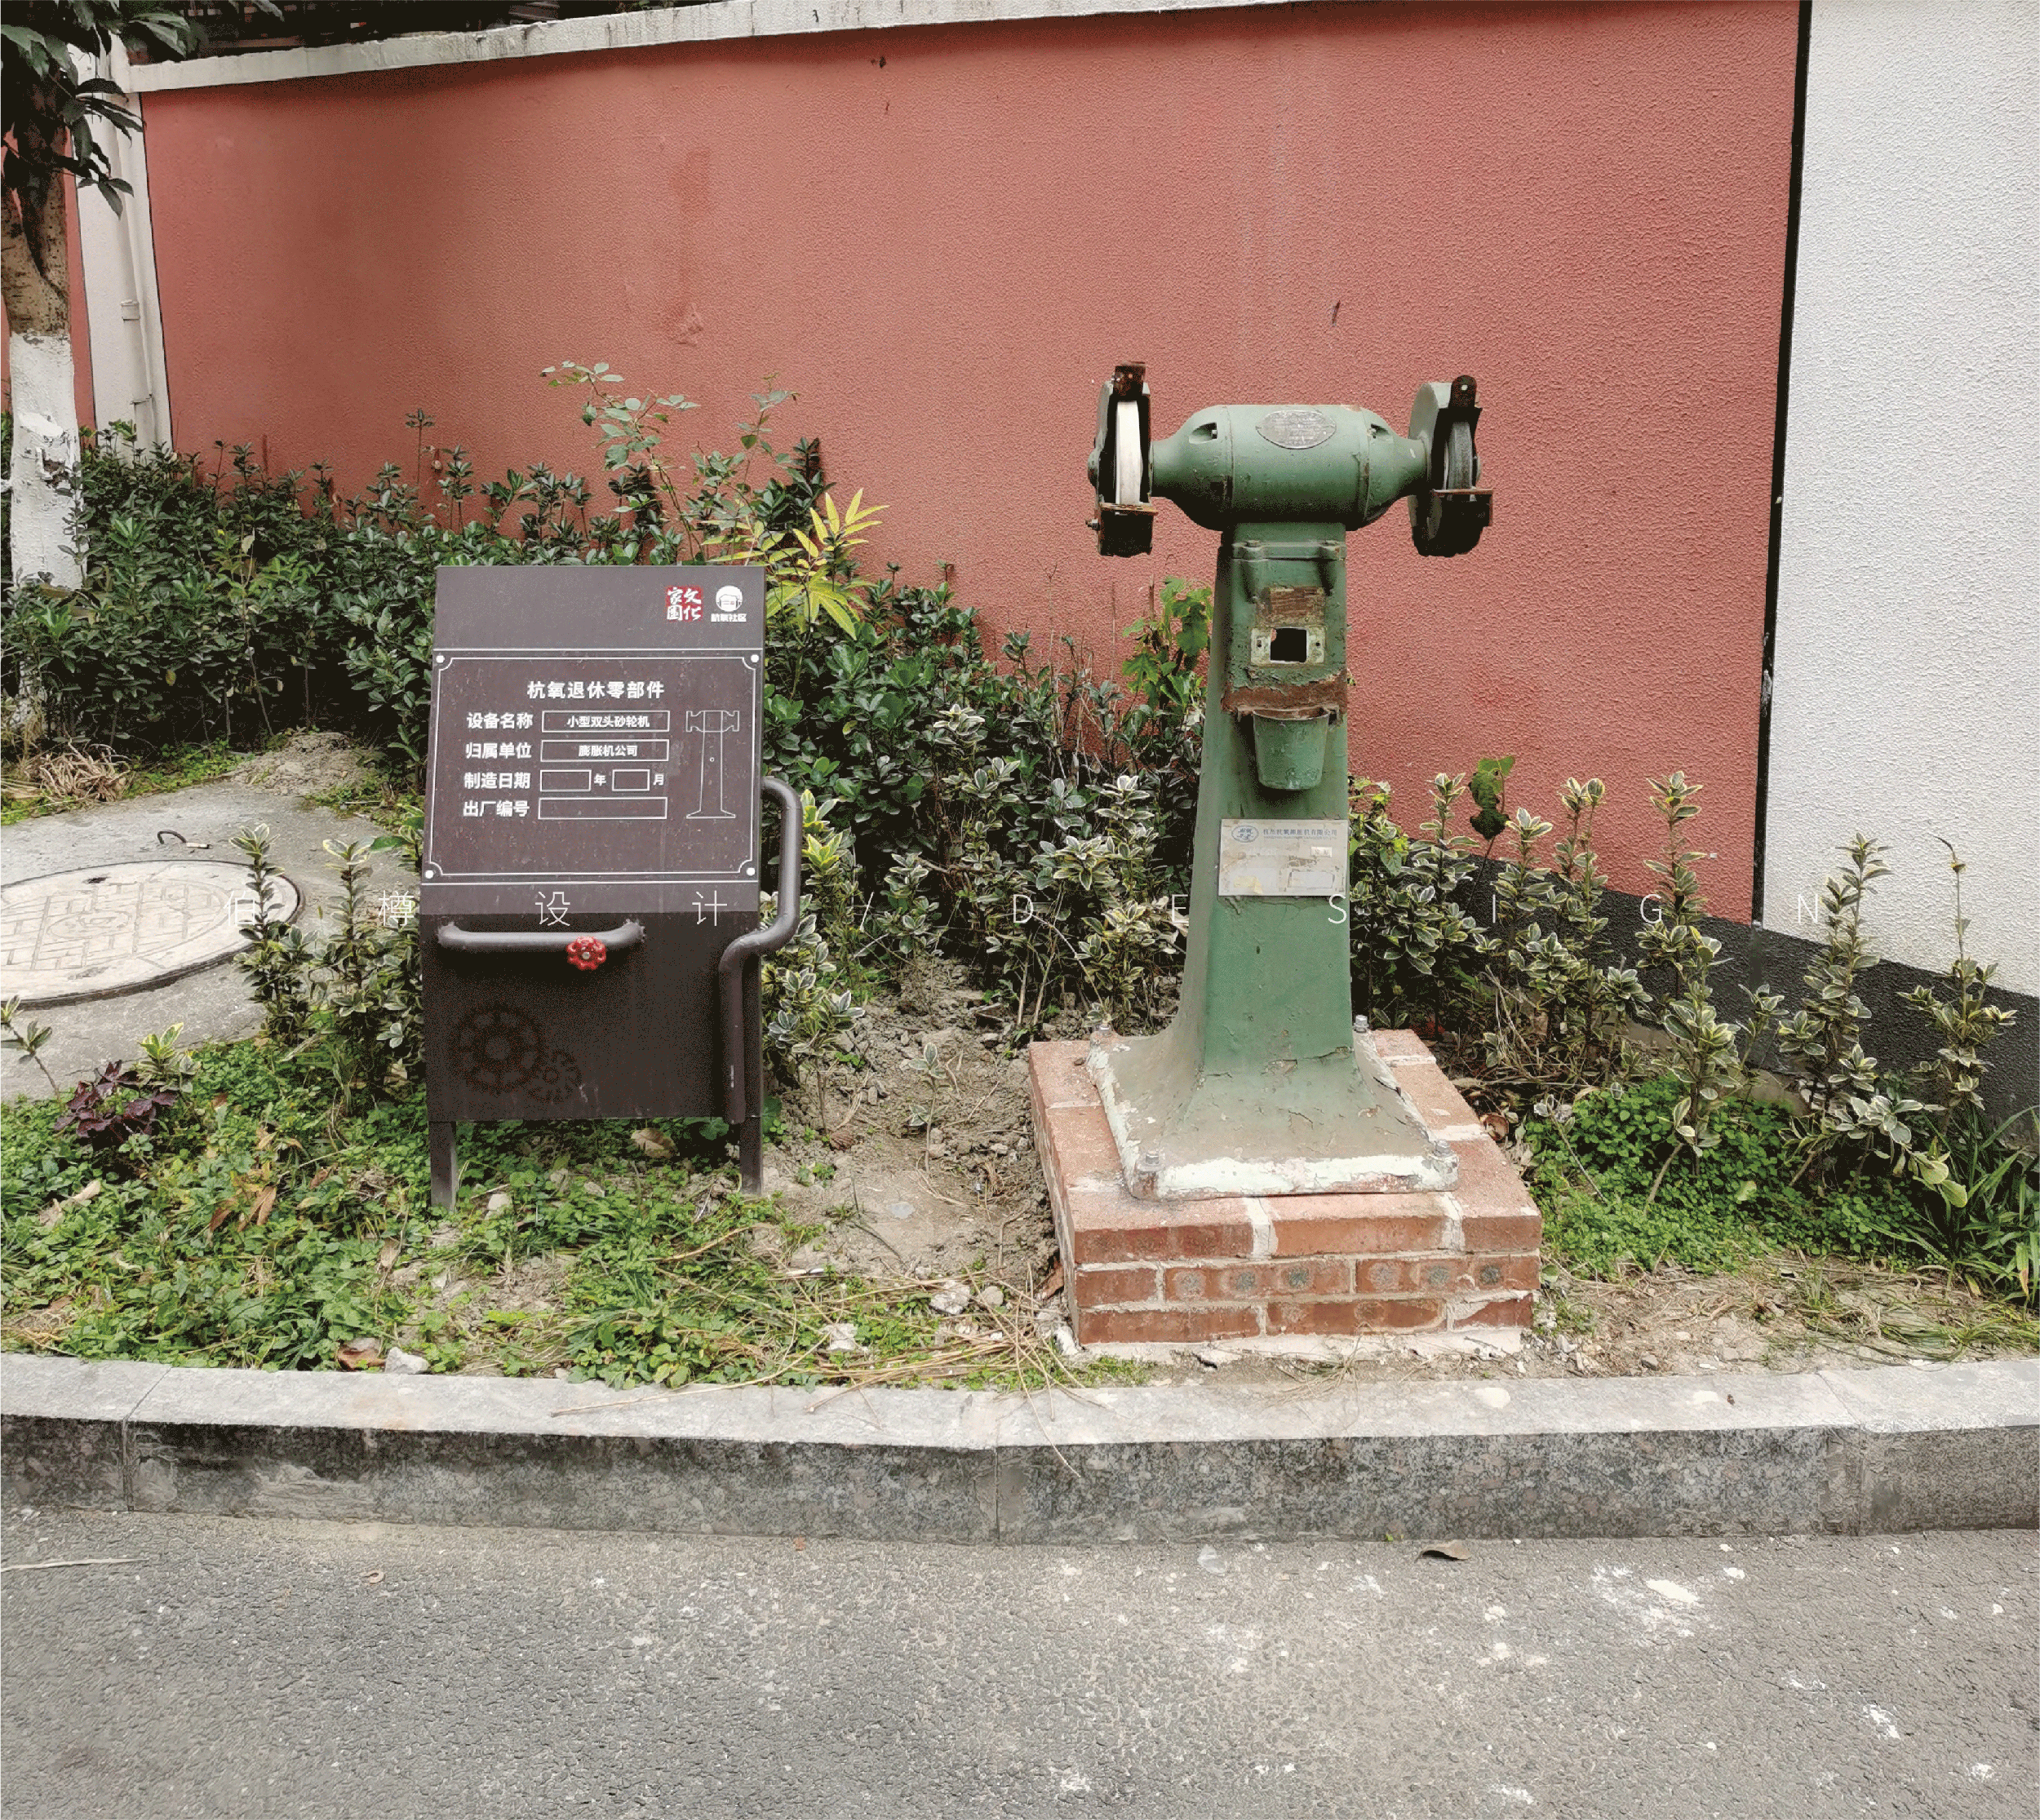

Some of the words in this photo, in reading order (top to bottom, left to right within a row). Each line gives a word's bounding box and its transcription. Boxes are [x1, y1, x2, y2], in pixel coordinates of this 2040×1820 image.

[527, 680, 665, 699] 杭氧退休零部件
[466, 712, 534, 729] 设备名称
[566, 715, 650, 728] 小型双头砂轮机
[465, 742, 532, 759] 归属单位
[578, 745, 638, 757] 膨胀机公司
[463, 772, 531, 790] 制造日期
[593, 773, 607, 786] 年
[653, 773, 665, 786] 月
[462, 800, 530, 817] 出厂编号
